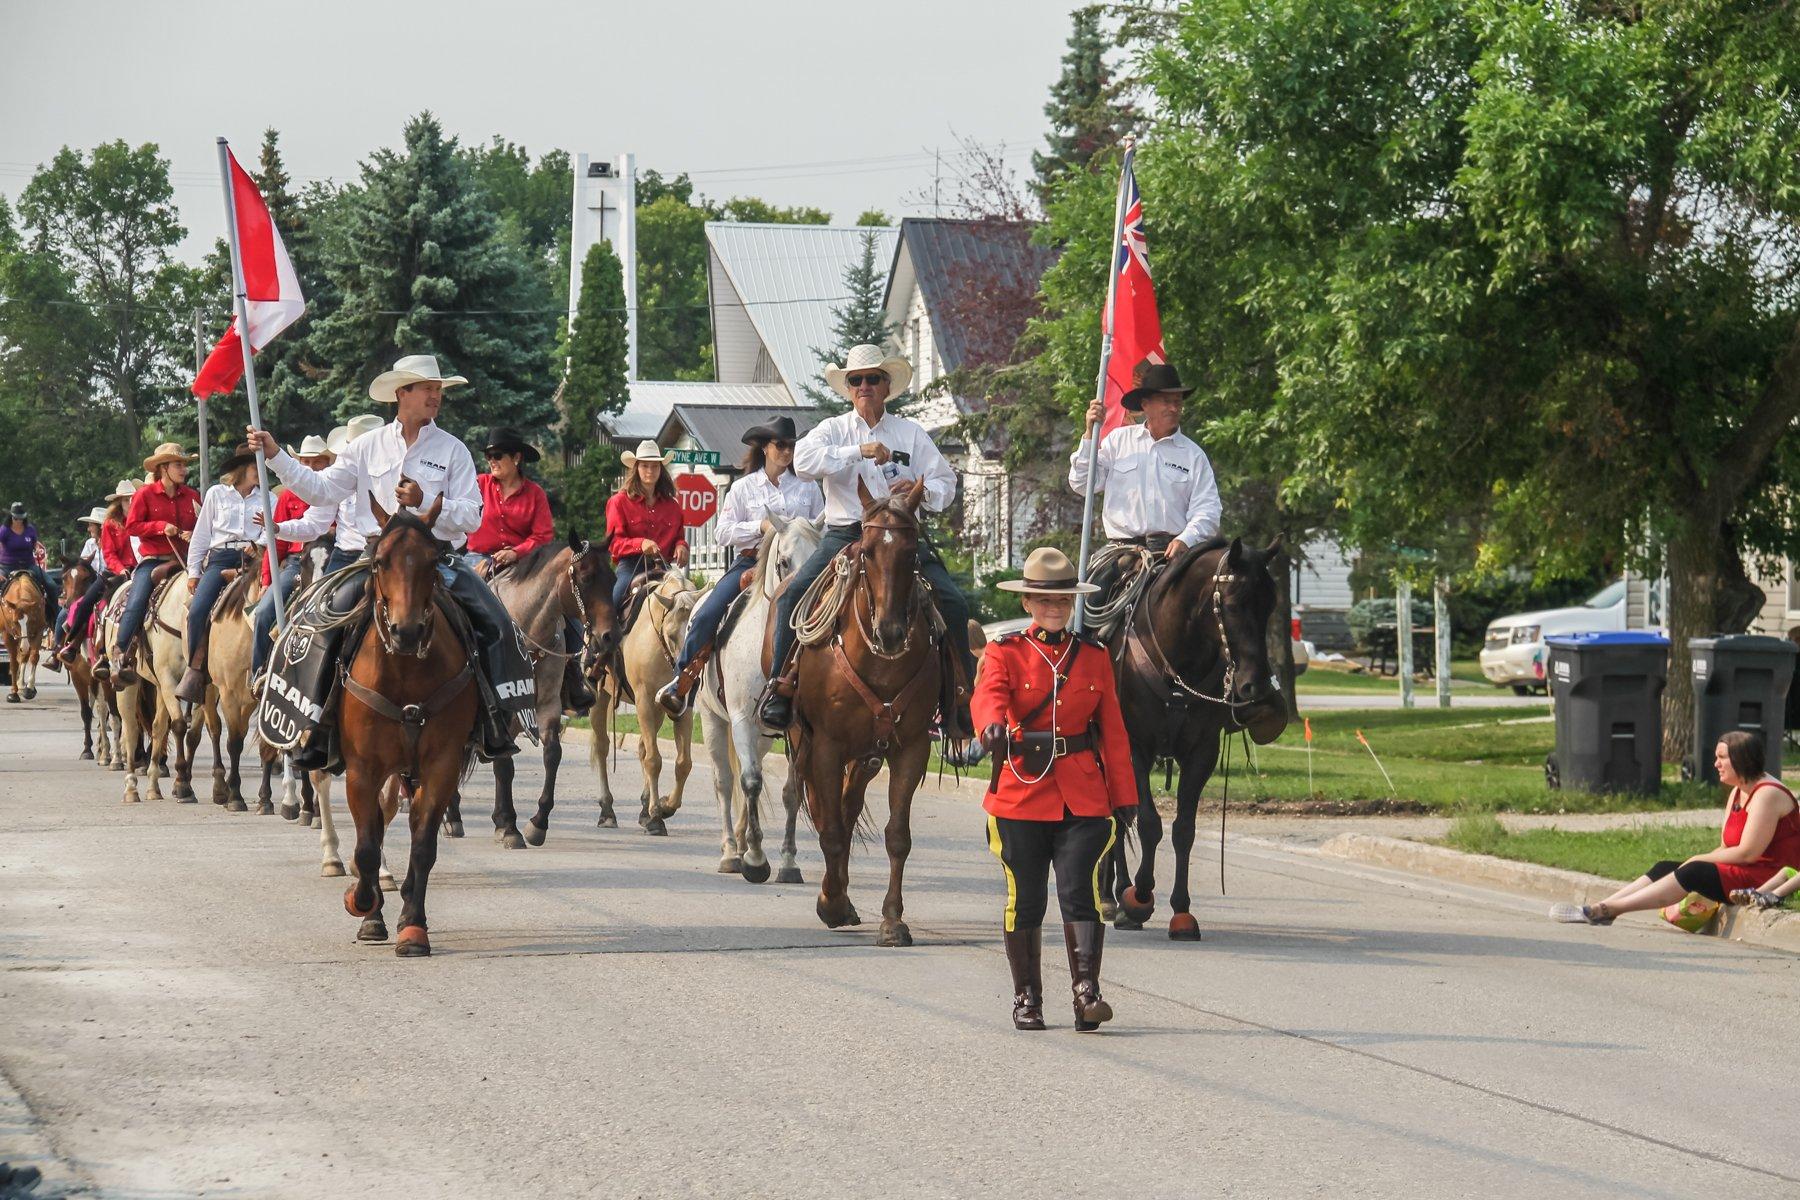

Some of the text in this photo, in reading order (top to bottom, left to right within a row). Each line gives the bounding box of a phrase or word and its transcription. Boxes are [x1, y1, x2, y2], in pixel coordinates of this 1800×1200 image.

[673, 451, 718, 463] OYNE AVE W
[679, 490, 714, 511] TOP
[270, 672, 322, 724] RAM
[264, 700, 295, 741] VOLD
